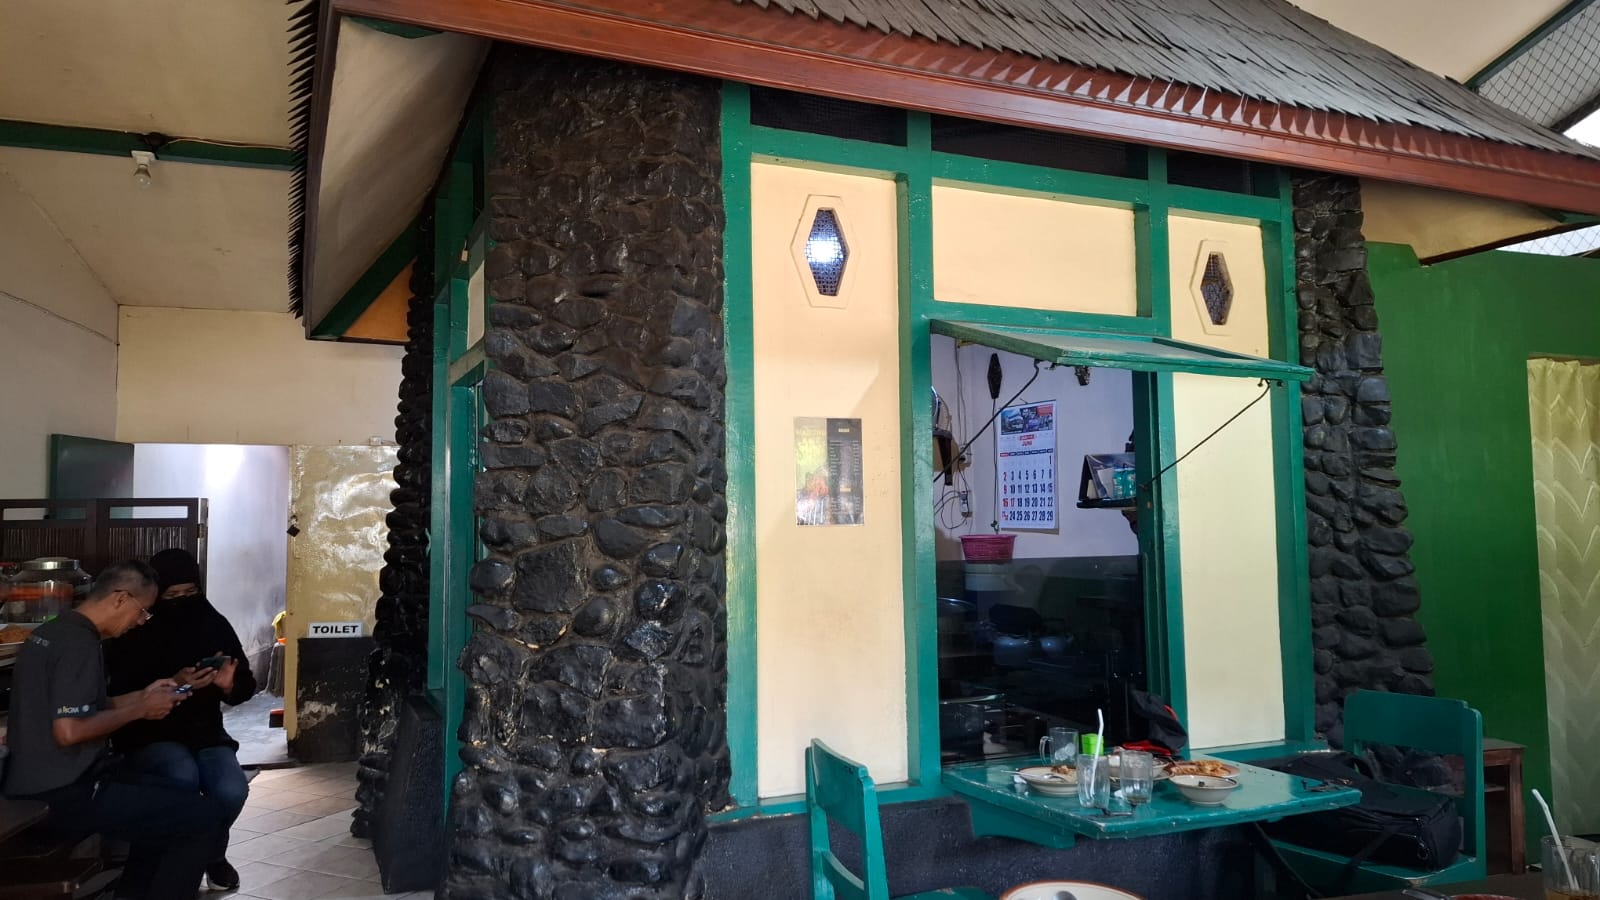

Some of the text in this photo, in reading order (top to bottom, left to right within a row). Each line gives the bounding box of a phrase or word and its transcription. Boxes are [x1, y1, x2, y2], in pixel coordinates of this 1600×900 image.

[1004, 472, 1006, 481] 2
[1011, 471, 1014, 480] 3
[1019, 470, 1021, 480] 4
[1026, 470, 1028, 480] 5
[1033, 470, 1036, 480] 6
[1042, 469, 1044, 479] 7
[1004, 484, 1007, 494] 9
[1010, 484, 1015, 494] 10
[1018, 484, 1022, 493] 11
[1025, 484, 1029, 493] 12
[1032, 484, 1037, 493] 13
[1040, 483, 1045, 493] 14
[1003, 497, 1052, 507] 16 17 18 19 20 21 22
[1010, 511, 1015, 520] 24
[1017, 511, 1022, 520] 25
[1024, 511, 1030, 520] 26
[1032, 511, 1037, 520] 27
[1039, 511, 1045, 520] 28
[1047, 511, 1053, 520] 29
[312, 625, 358, 634] TOILET
